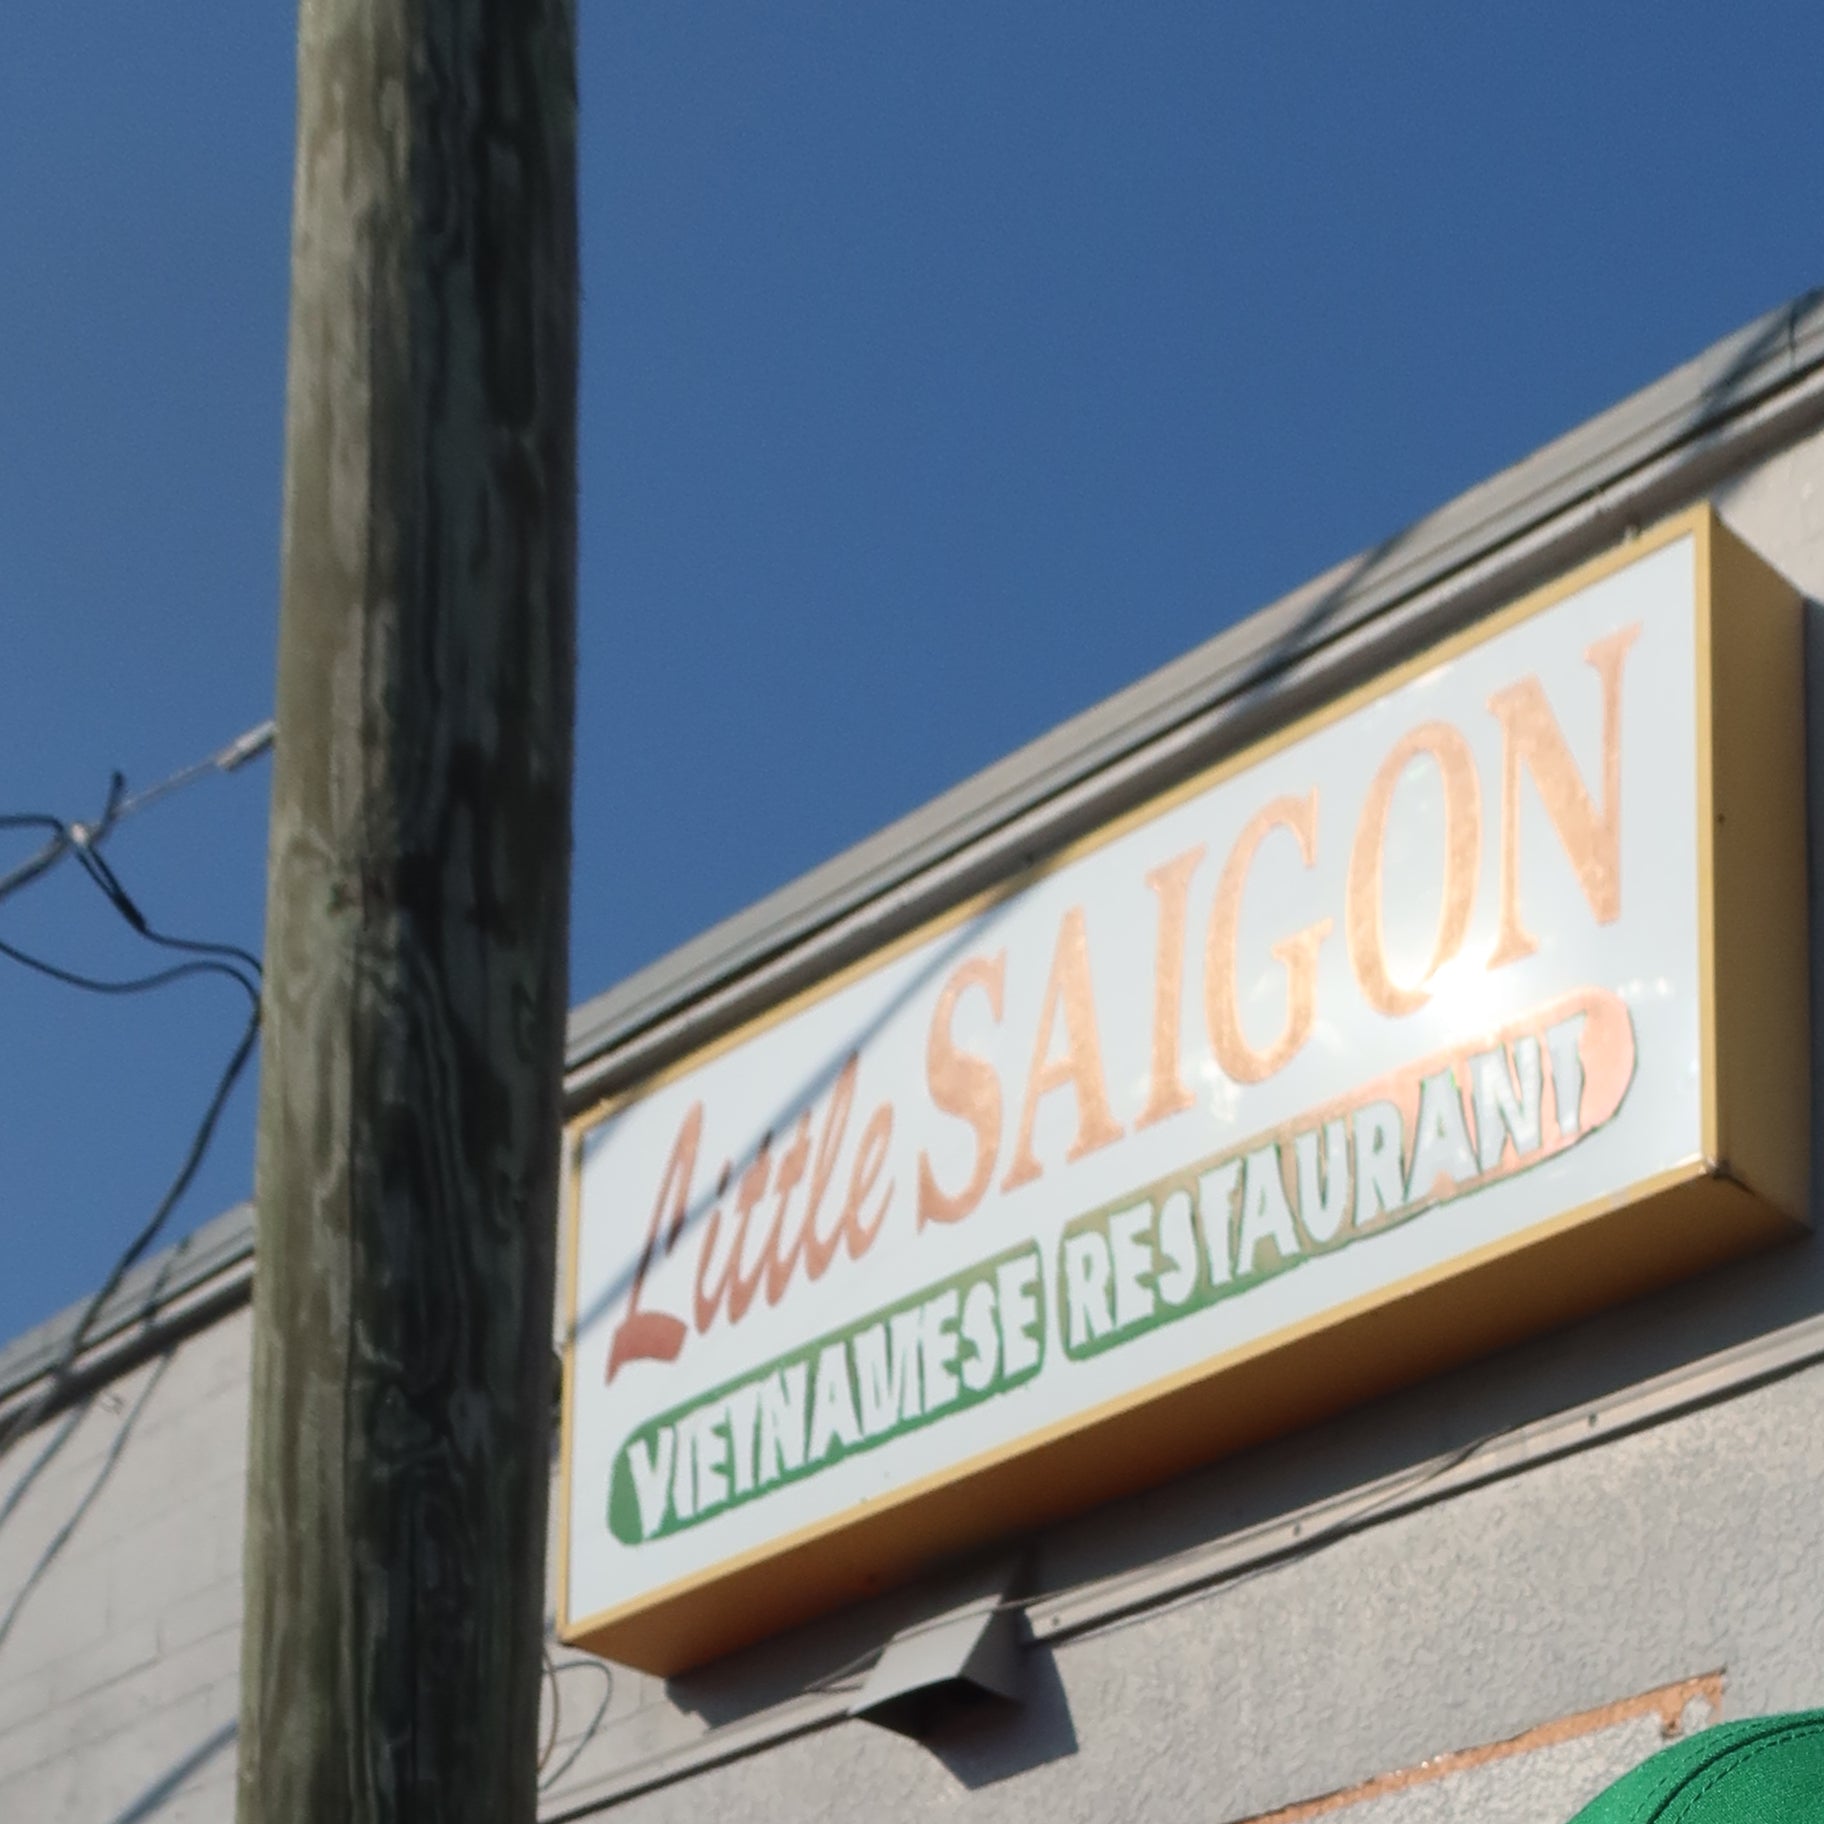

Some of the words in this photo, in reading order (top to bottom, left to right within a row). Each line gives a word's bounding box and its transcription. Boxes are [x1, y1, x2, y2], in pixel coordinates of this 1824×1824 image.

[607, 1056, 894, 1383] Little
[918, 625, 1640, 1230] SAIGON
[629, 1246, 1044, 1537] VIETNAMESE
[1071, 1018, 1583, 1318] RESTAURANT
